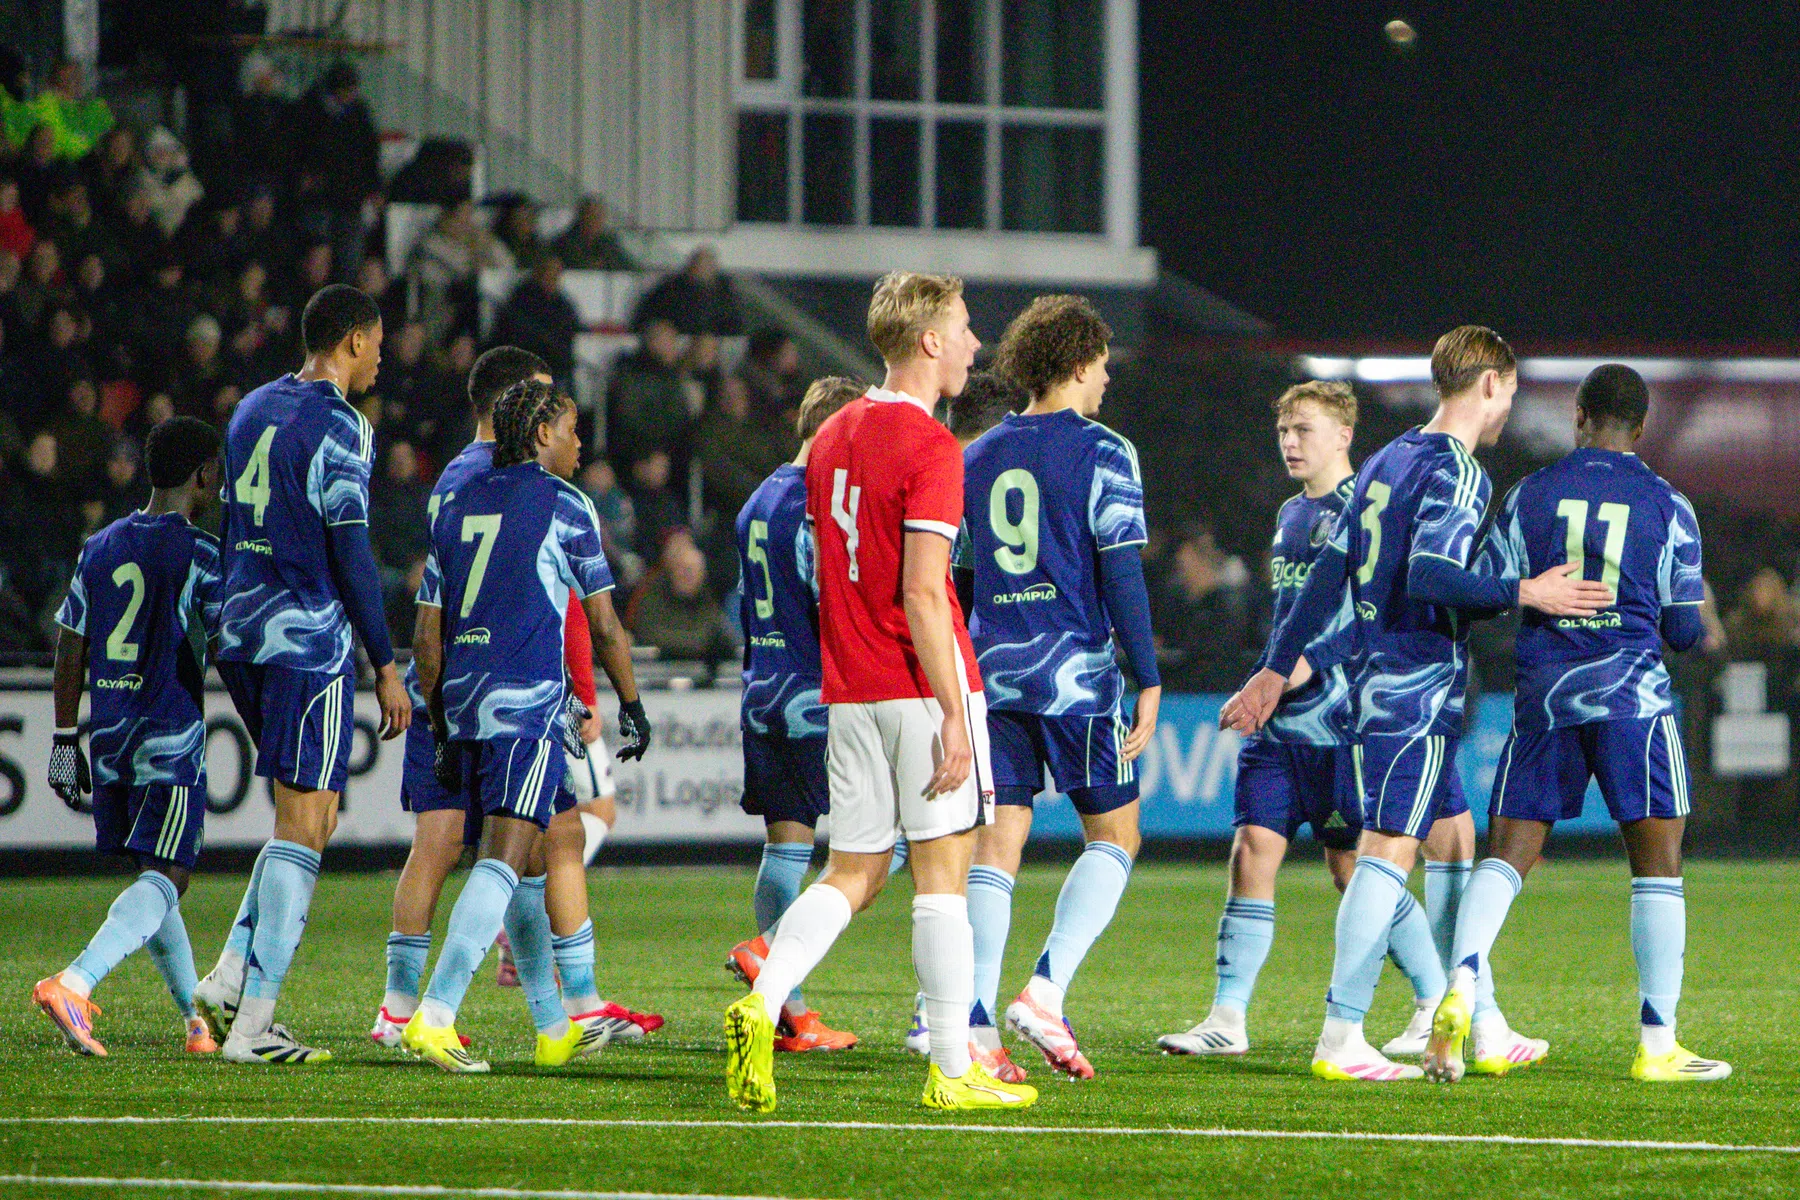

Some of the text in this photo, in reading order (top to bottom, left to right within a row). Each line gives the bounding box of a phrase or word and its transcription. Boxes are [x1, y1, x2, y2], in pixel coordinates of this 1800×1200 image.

[235, 425, 278, 526] 4
[831, 468, 861, 581] 4
[990, 468, 1040, 574] 9
[460, 513, 502, 618] 7
[748, 520, 774, 619] 5
[1357, 480, 1392, 585] 3
[1556, 498, 1630, 605] 11
[106, 562, 145, 661] 2
[993, 584, 1057, 604] OLYMPIA
[96, 676, 143, 691] OLYMPIA
